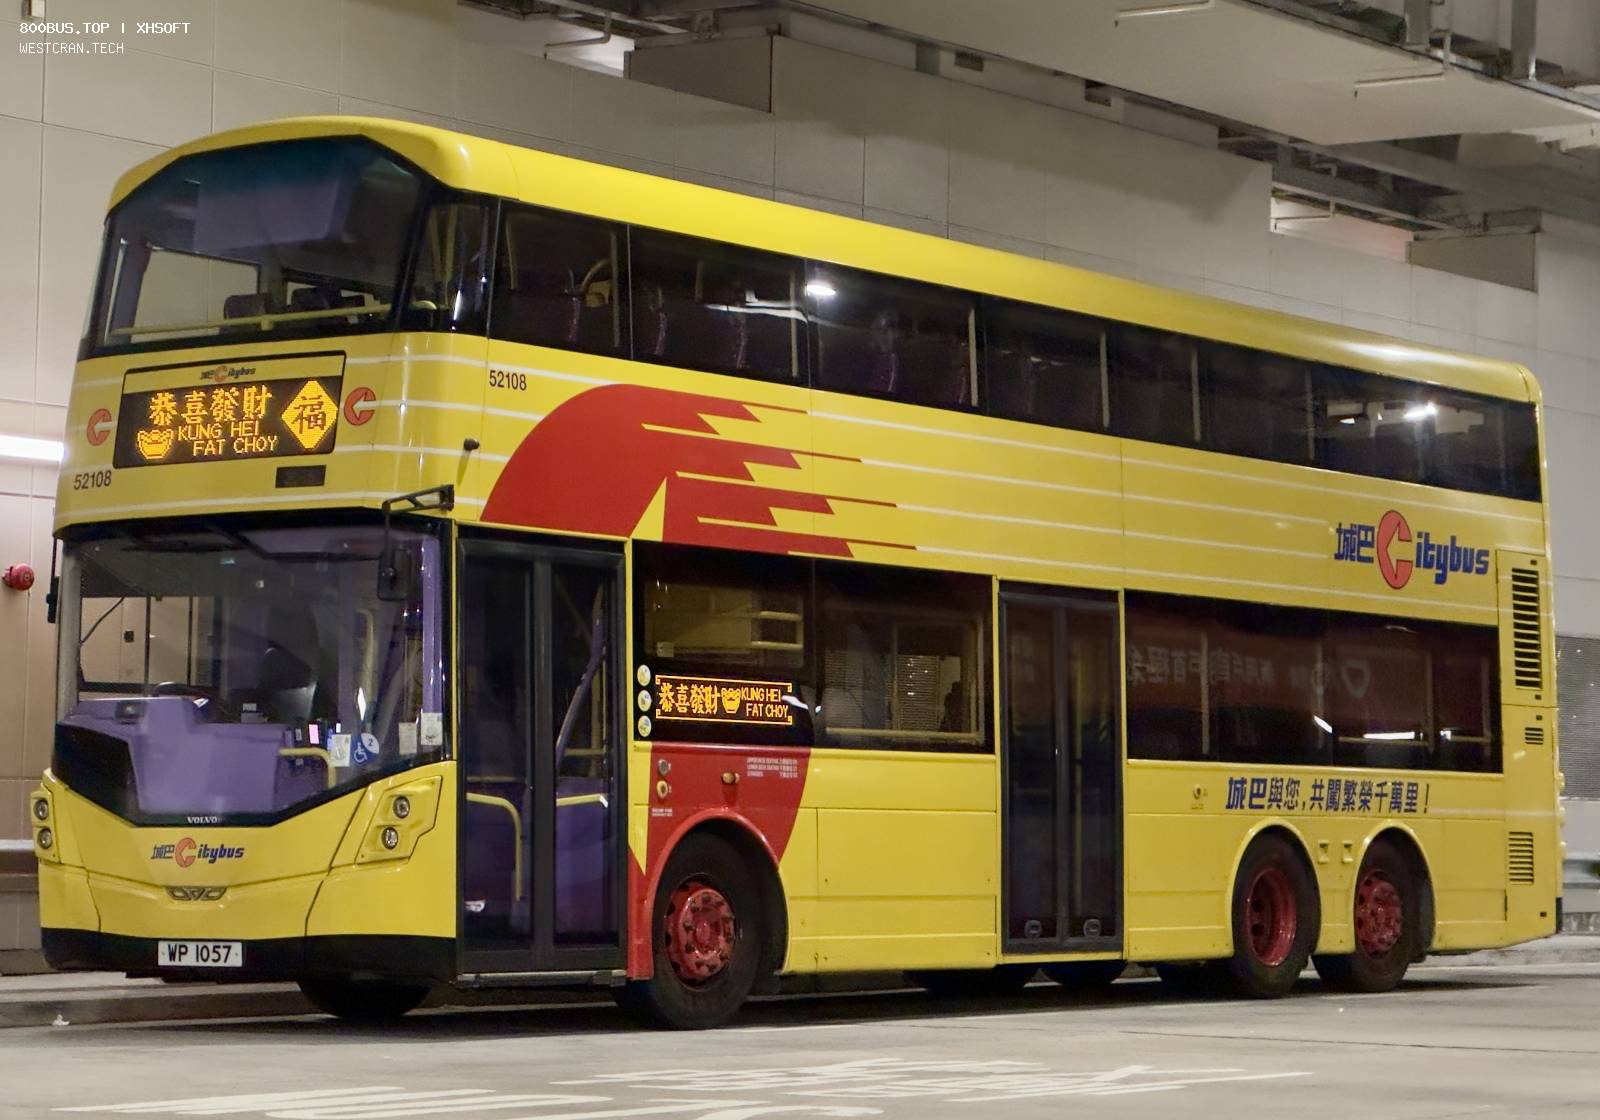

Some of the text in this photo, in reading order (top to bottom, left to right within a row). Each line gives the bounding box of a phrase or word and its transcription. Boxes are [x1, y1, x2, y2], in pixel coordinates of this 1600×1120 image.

[489, 369, 527, 391] 52108
[149, 384, 273, 426] 恭喜發財
[291, 395, 327, 434] 福
[178, 420, 259, 441] KUNG HEI
[192, 435, 278, 457] FAT CHOY
[73, 470, 112, 490] 52108
[1334, 509, 1490, 590] 城巴 Citybus
[659, 682, 721, 714] 恭喜發財
[741, 687, 782, 702] KUNG HEI
[746, 703, 789, 718] FAT CHOY
[187, 816, 218, 824] VOLVO
[175, 837, 245, 868] Citybus
[168, 944, 232, 963] WP 1057
